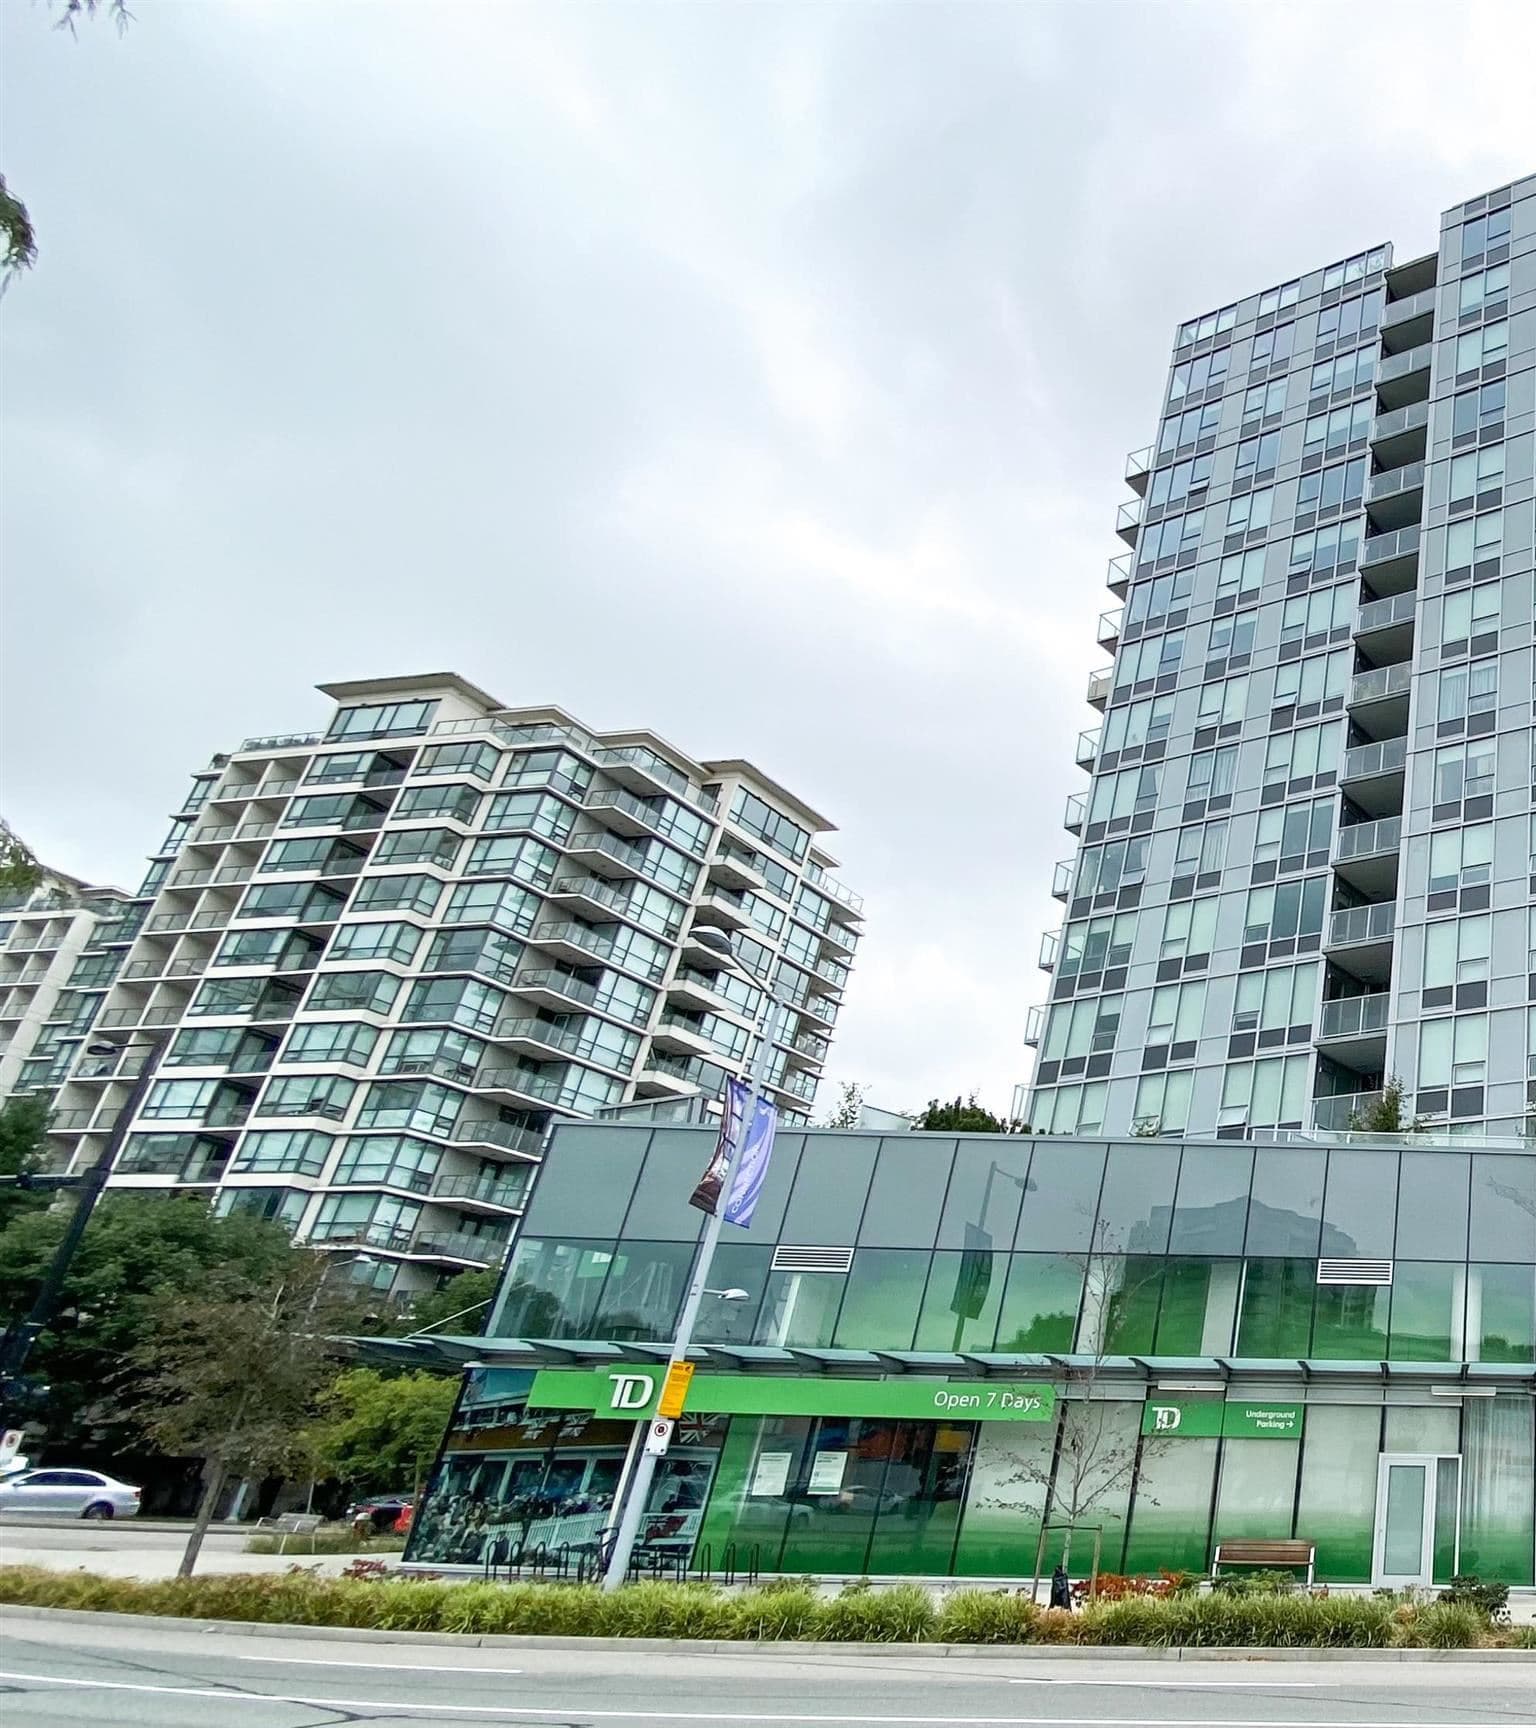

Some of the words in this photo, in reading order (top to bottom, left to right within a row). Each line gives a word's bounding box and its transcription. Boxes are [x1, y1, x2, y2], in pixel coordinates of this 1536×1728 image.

[608, 1373, 654, 1409] TD
[933, 1390, 980, 1411] Open
[986, 1392, 997, 1408] 7
[1001, 1392, 1041, 1413] Days
[1152, 1406, 1182, 1430] TD
[1245, 1409, 1296, 1419] Underground
[1256, 1418, 1286, 1430] Parking
